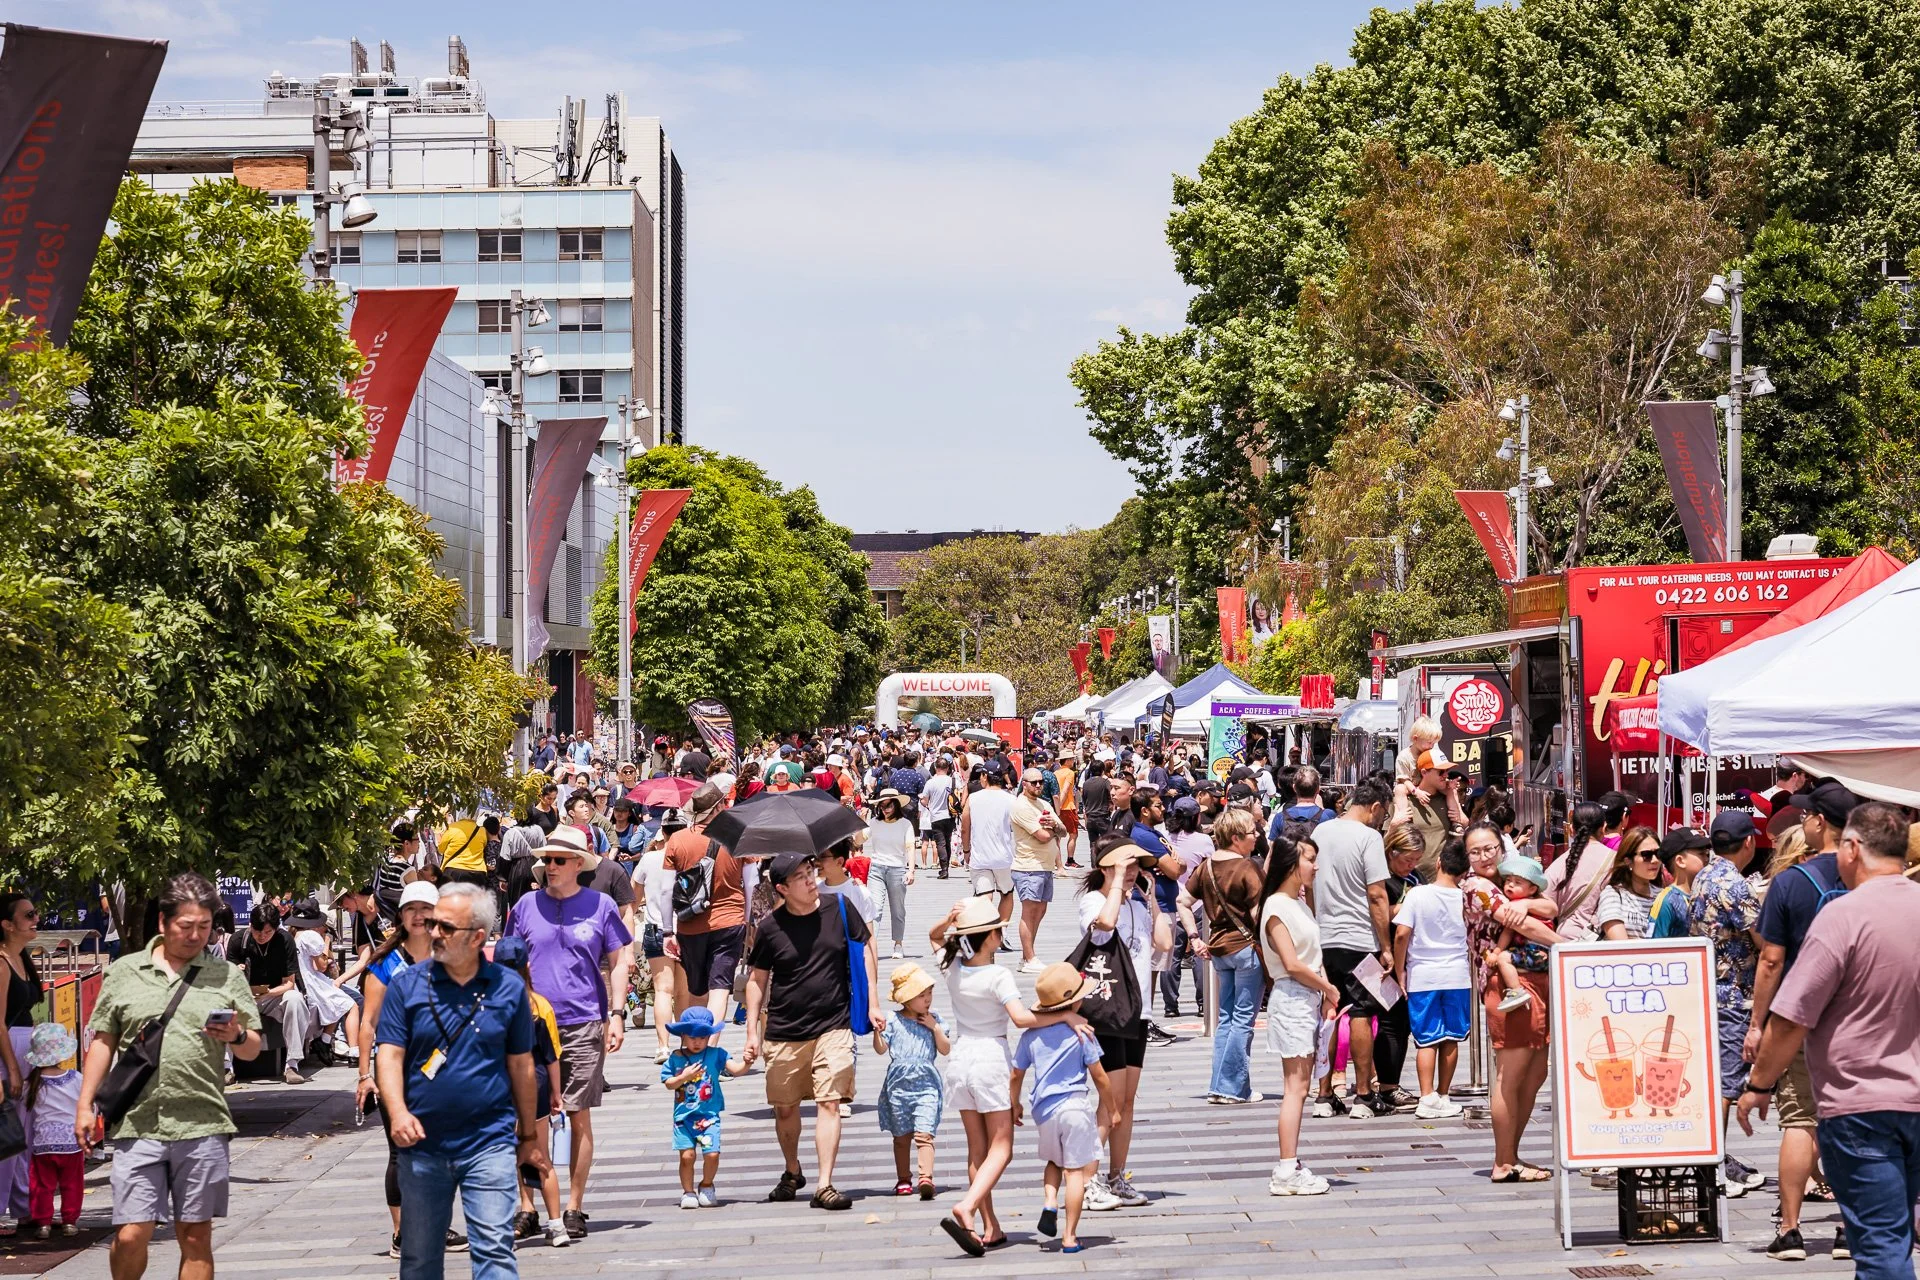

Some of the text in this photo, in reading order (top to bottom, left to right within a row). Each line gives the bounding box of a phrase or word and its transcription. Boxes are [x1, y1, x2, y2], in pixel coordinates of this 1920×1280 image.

[1599, 577, 1616, 587] FOR
[1618, 576, 1634, 586] ALL
[1637, 575, 1659, 585] YOUR
[1661, 573, 1702, 584] CATERING
[1704, 572, 1735, 583] NEEDS,
[1736, 571, 1754, 581] YOU
[1755, 570, 1775, 580] MAY
[1777, 568, 1816, 579] CONTACT
[1818, 568, 1830, 578] US
[1655, 584, 1789, 605] 0422 606 162
[903, 678, 991, 691] WELCOME
[1574, 962, 1688, 989] BUBBLE
[1605, 989, 1666, 1014] TEA
[1589, 1124, 1617, 1135] Your
[1619, 1123, 1643, 1134] new
[1619, 1134, 1663, 1145] in a cup
